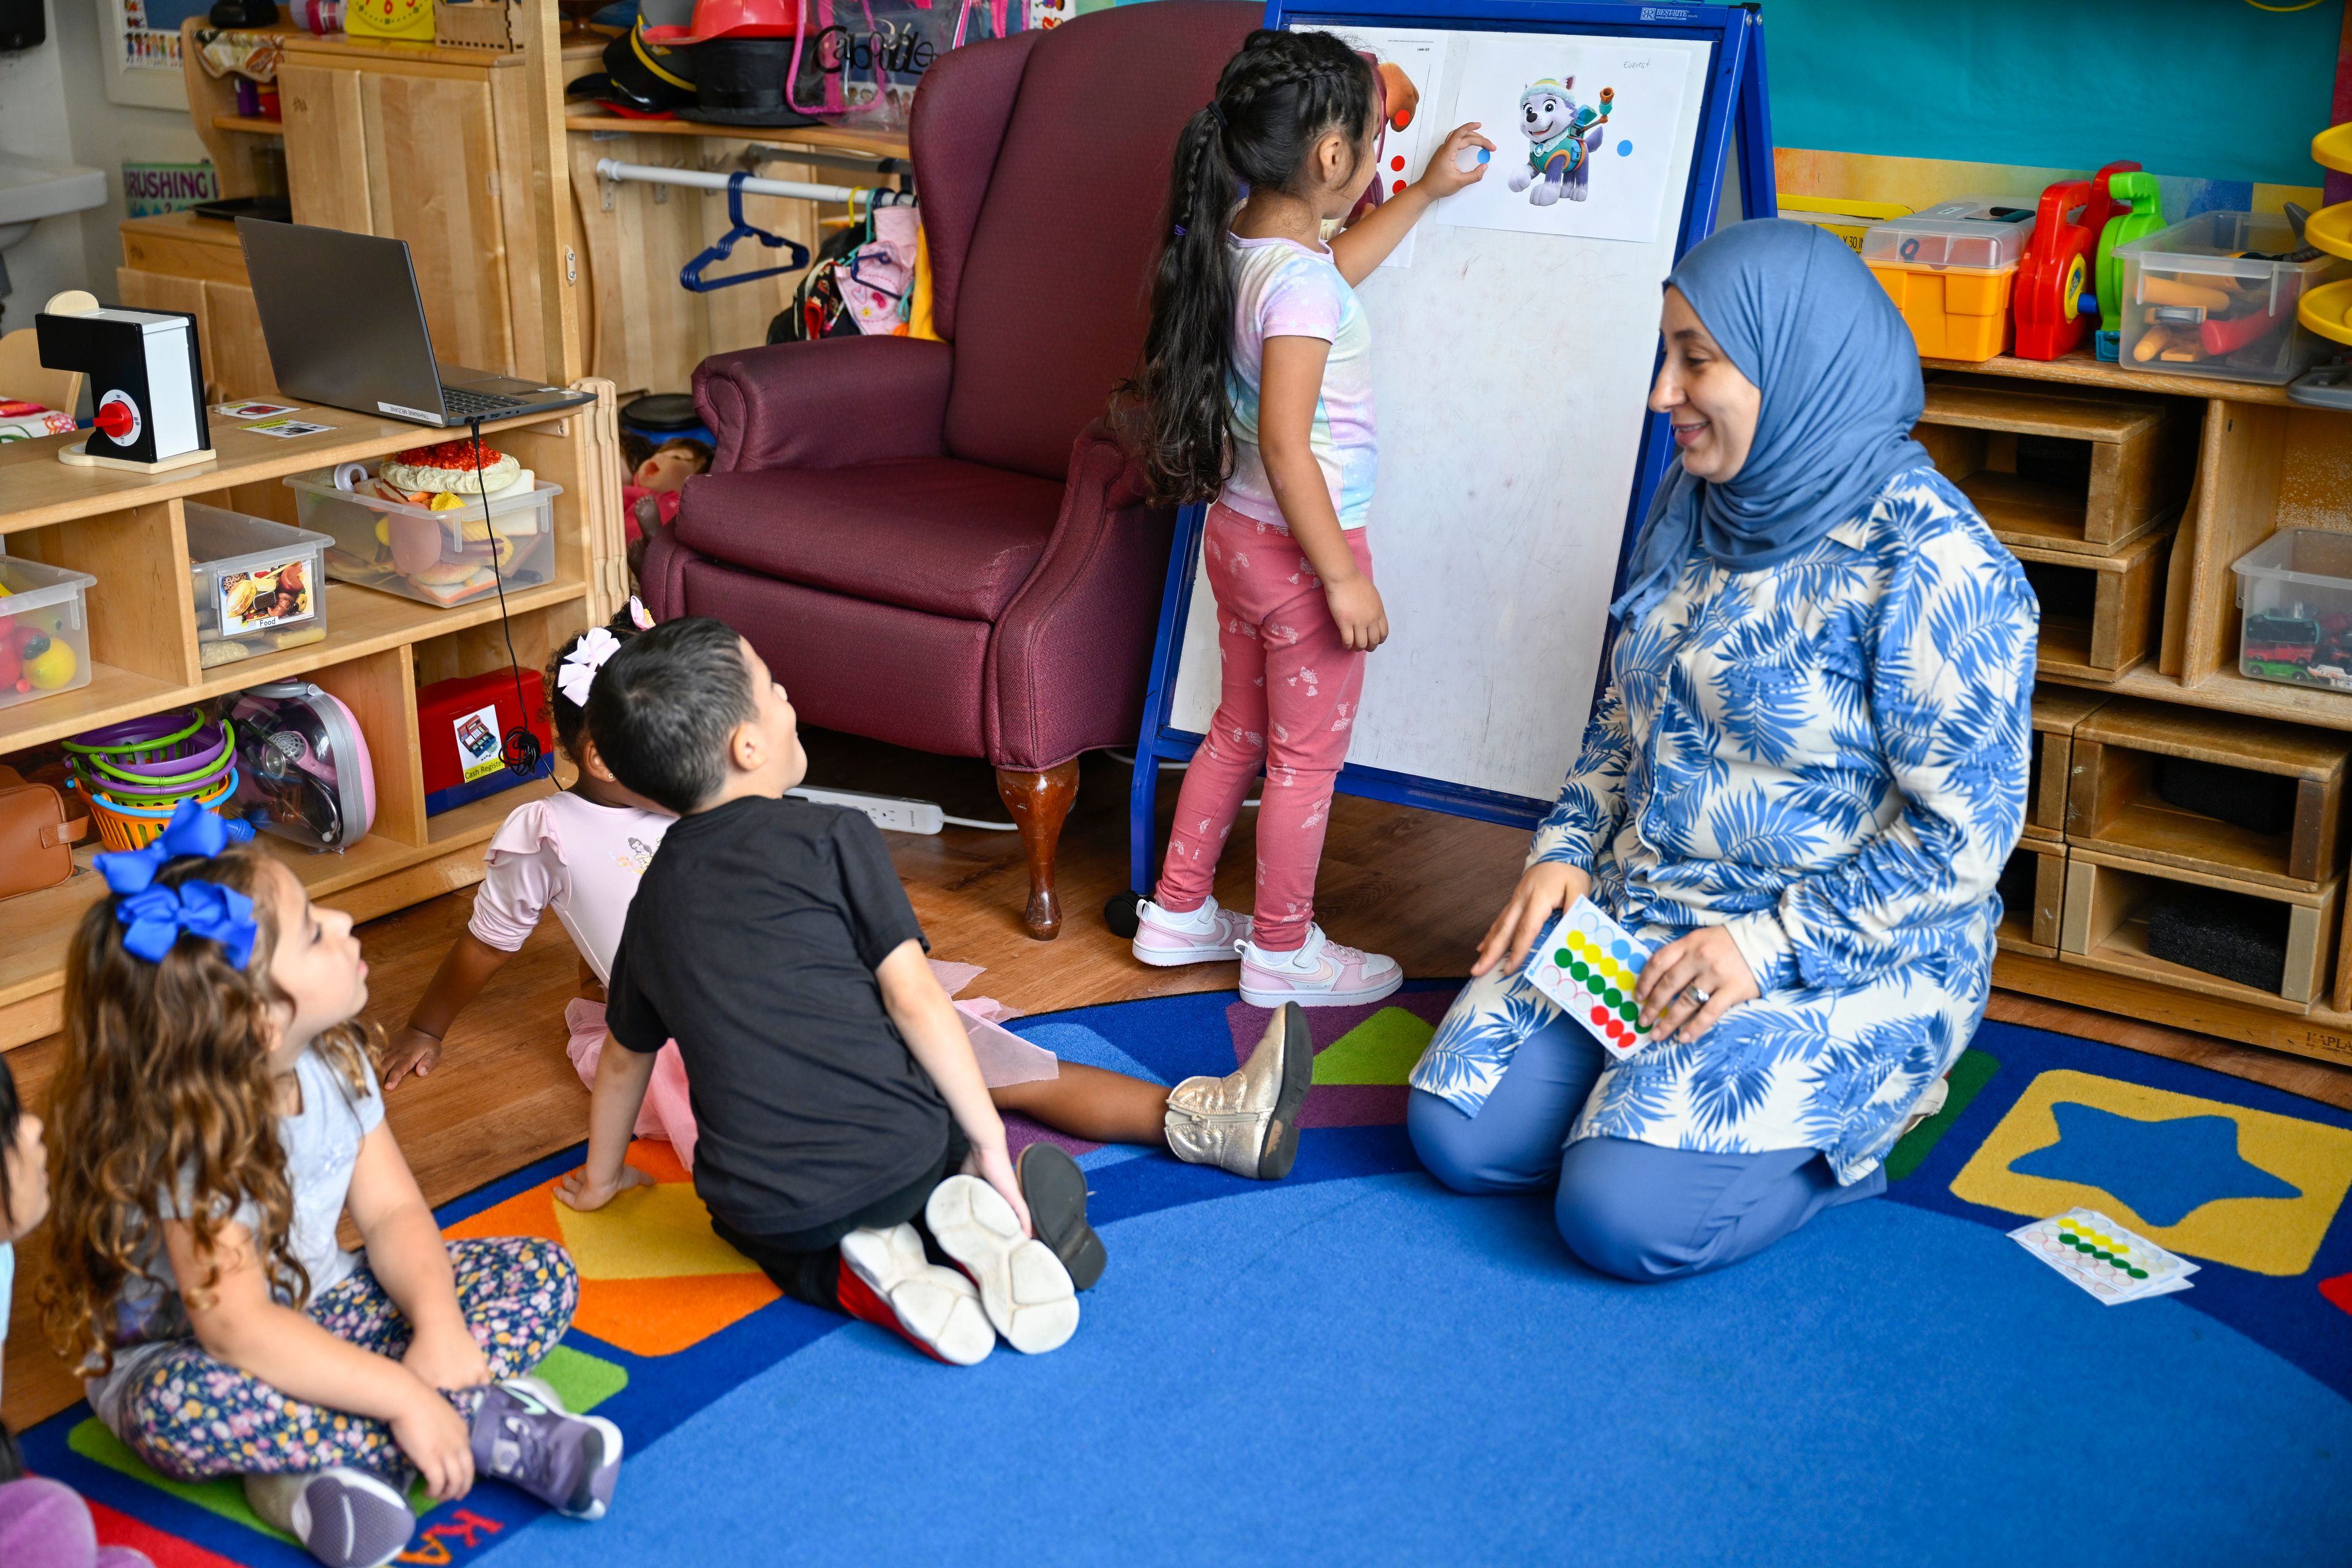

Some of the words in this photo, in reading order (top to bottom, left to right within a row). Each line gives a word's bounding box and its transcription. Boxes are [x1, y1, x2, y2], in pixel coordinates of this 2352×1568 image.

[1623, 58, 1650, 69] Everest
[124, 171, 208, 198] RUSHING
[1849, 236, 1857, 248] 30
[260, 617, 276, 627] Food
[465, 769, 480, 779] Cash
